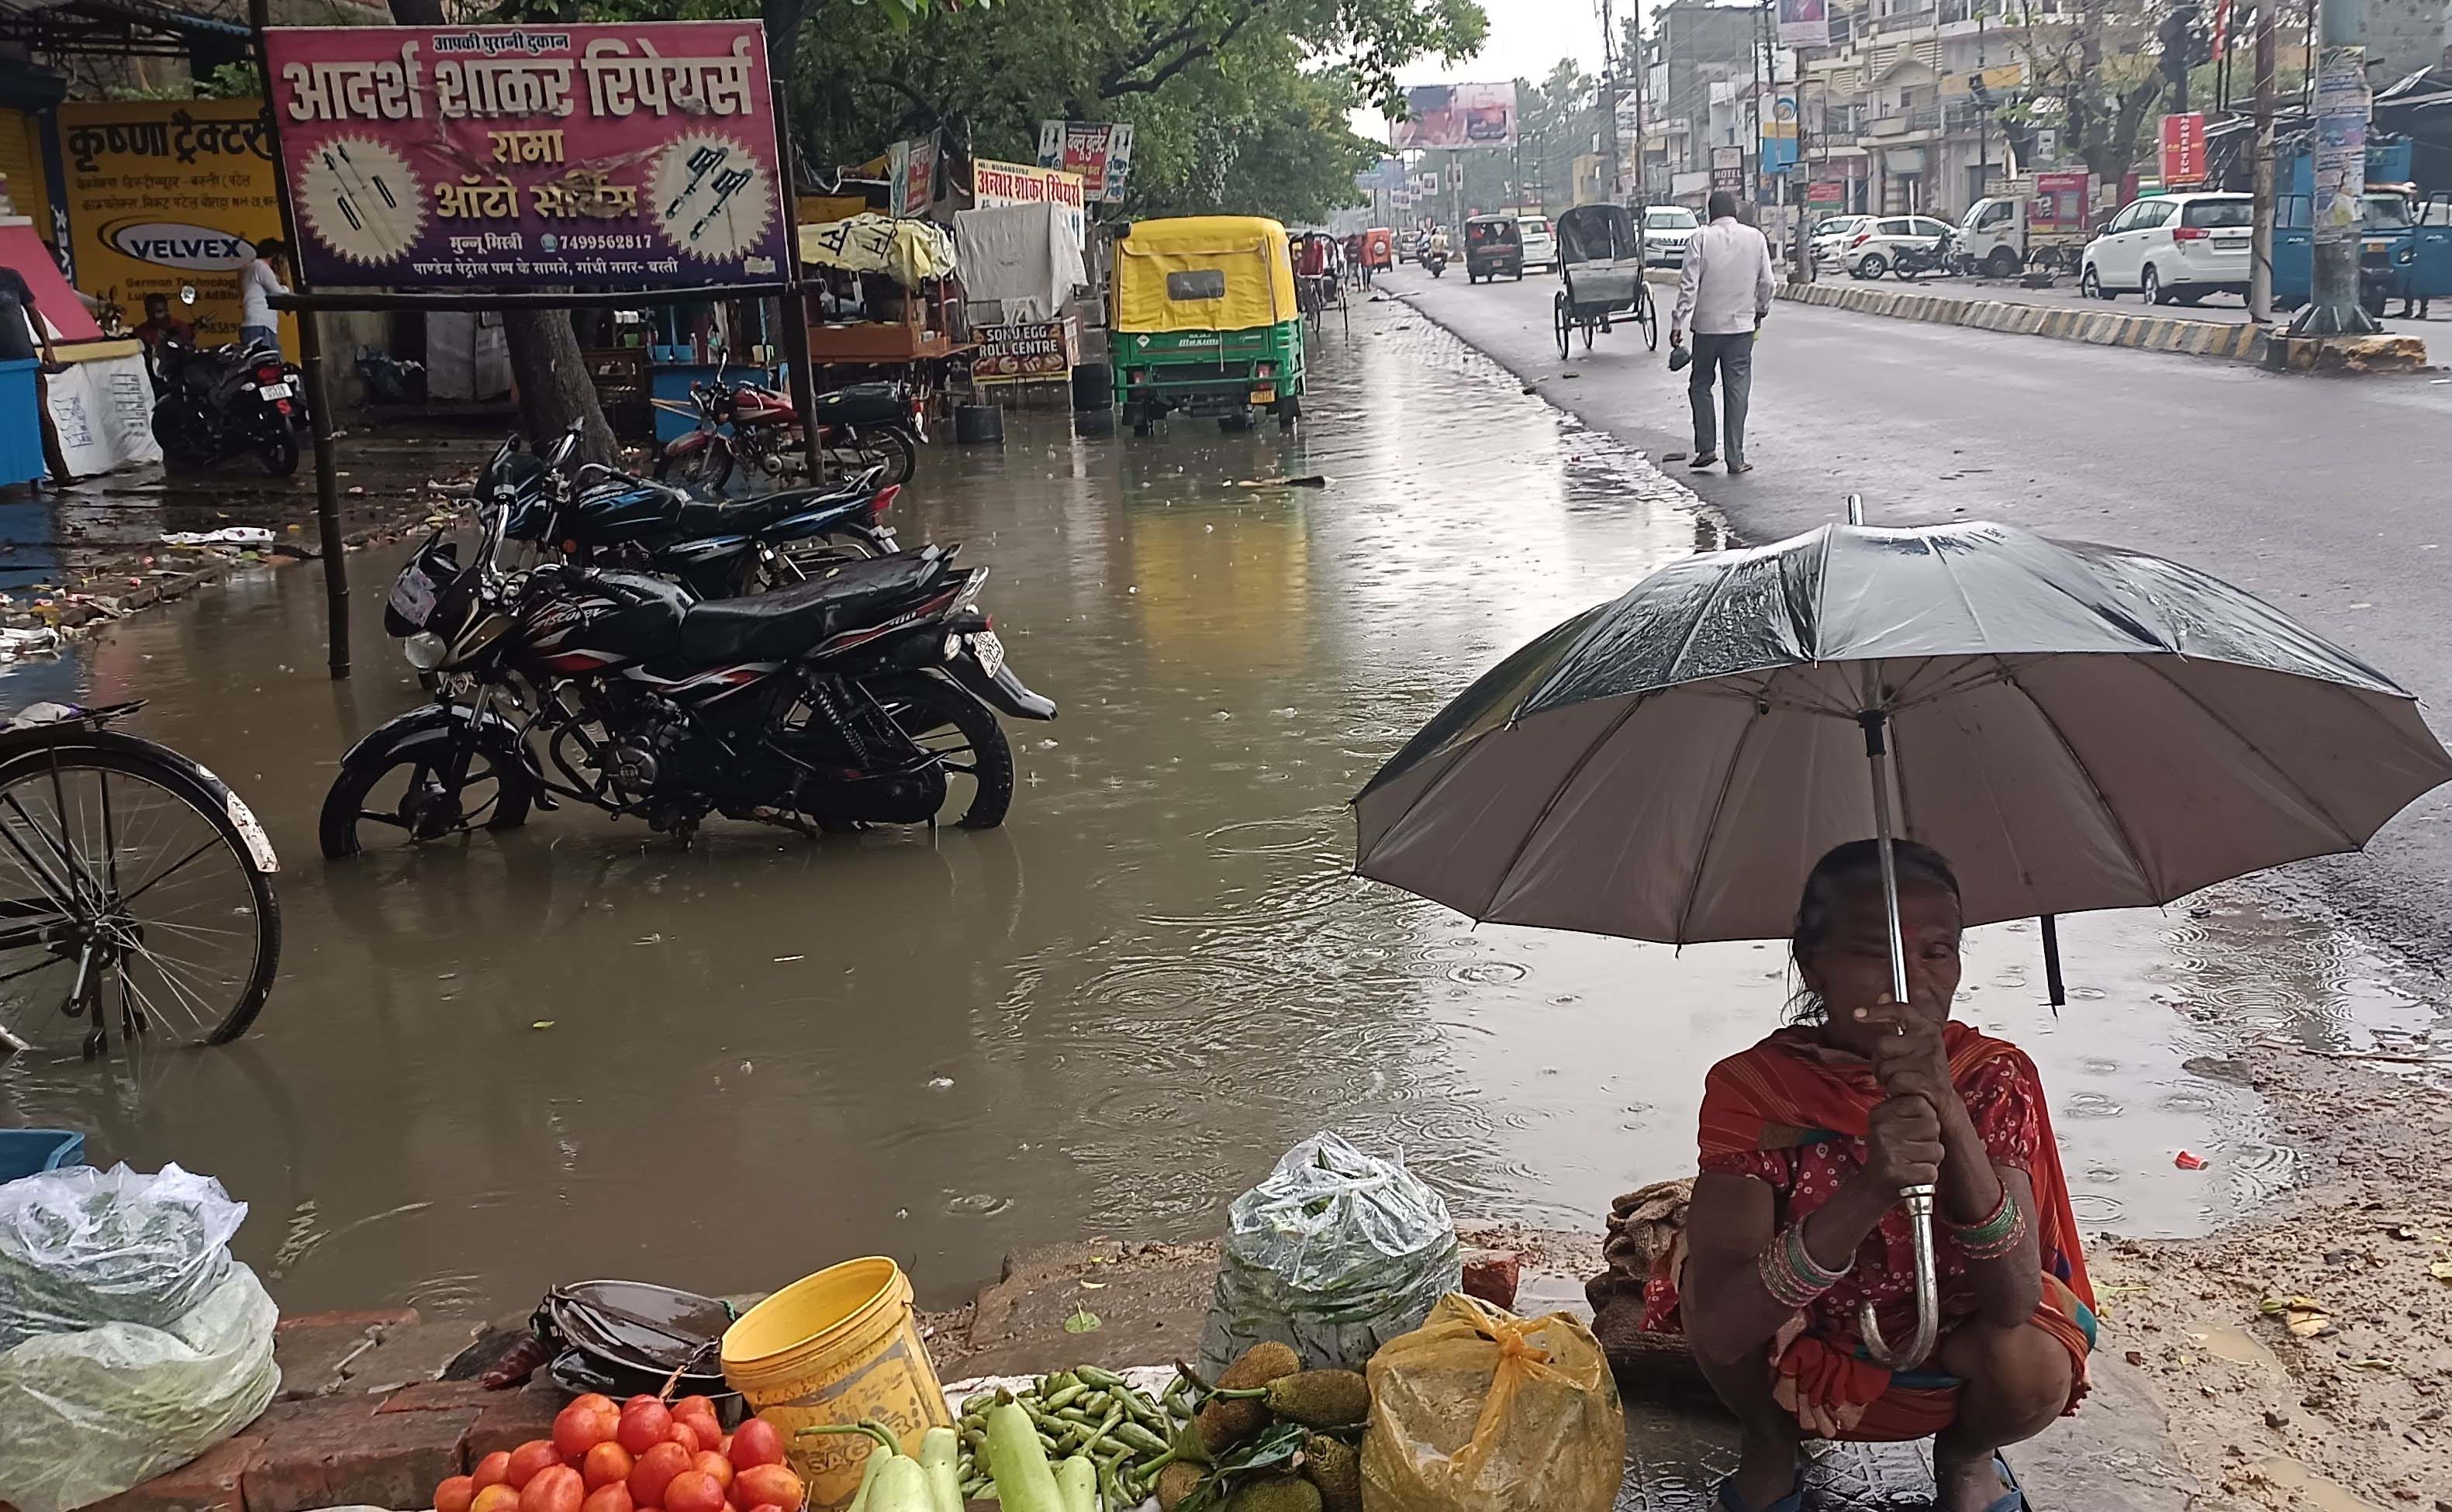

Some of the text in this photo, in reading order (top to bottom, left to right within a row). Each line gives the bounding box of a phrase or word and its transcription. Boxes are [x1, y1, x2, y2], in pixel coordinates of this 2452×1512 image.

[433, 31, 569, 54] आपकी पुरानी दुकान
[283, 36, 753, 120] आदर्श शाकर रिपेयर्स
[67, 122, 170, 173] कृष्णा
[487, 129, 564, 165] रामा
[2180, 117, 2190, 174] MOMENTUM
[1714, 169, 1742, 180] HOTEL
[434, 173, 520, 219] ऑटो
[1014, 174, 1045, 202] शाकर
[1046, 173, 1081, 208] रिपेयर्स
[130, 239, 242, 259] VELVEX
[560, 234, 652, 249] 7499562817
[413, 257, 452, 275] पाण्डेय
[454, 257, 489, 279] पेट्रोल
[490, 262, 513, 275] पम्प
[516, 257, 530, 274] के
[532, 257, 573, 277] सामने,
[575, 256, 606, 274] गांधी
[647, 256, 679, 274] बस्ती
[176, 276, 237, 289] Technolog
[1024, 326, 1047, 339] EGG
[979, 339, 1059, 357] ROLL CENTRE
[806, 1414, 913, 1473] SAGR
